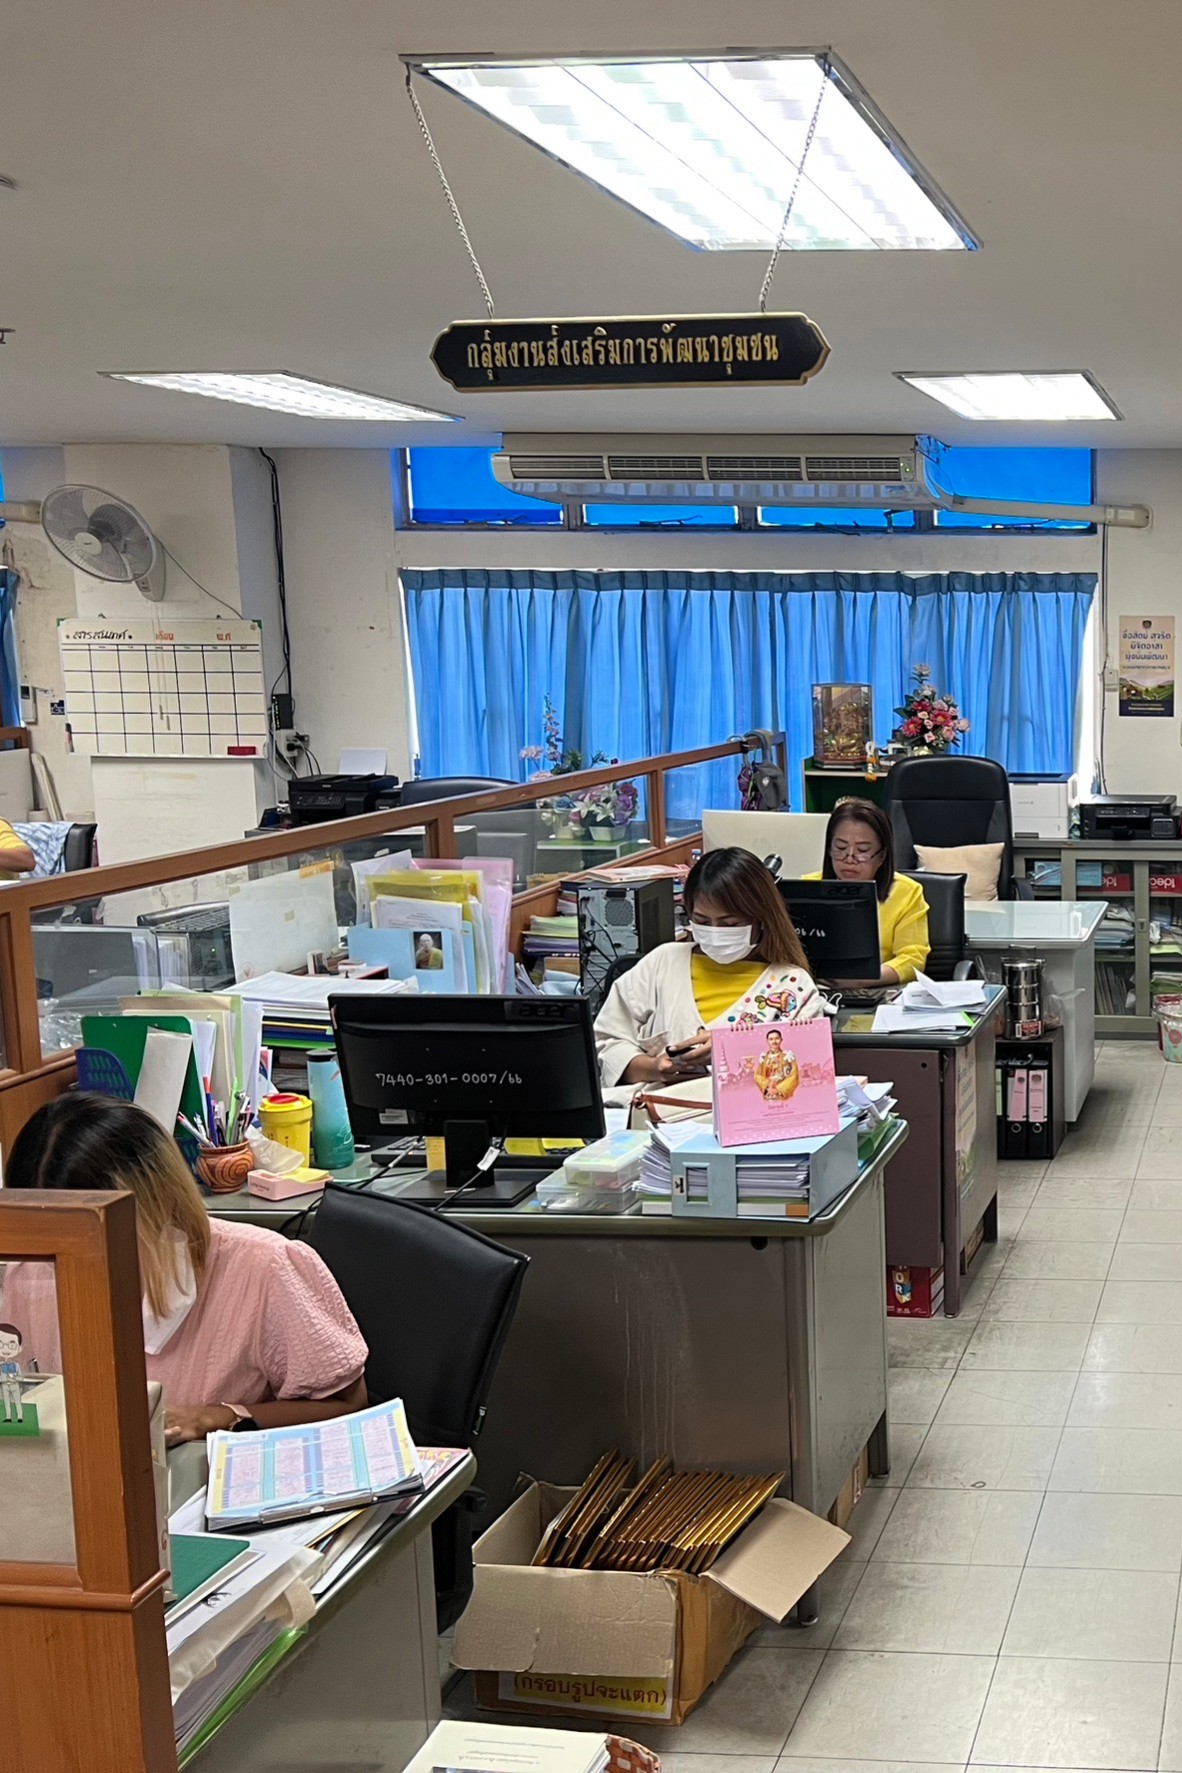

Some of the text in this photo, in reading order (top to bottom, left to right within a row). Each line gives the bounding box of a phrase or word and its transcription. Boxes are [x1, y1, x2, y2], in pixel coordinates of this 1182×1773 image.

[467, 322, 779, 380] กลุ่มงานส่งเสริมการพัฒนาชุมชน
[514, 1672, 667, 1706] (กรอบรูปจะแตก)
